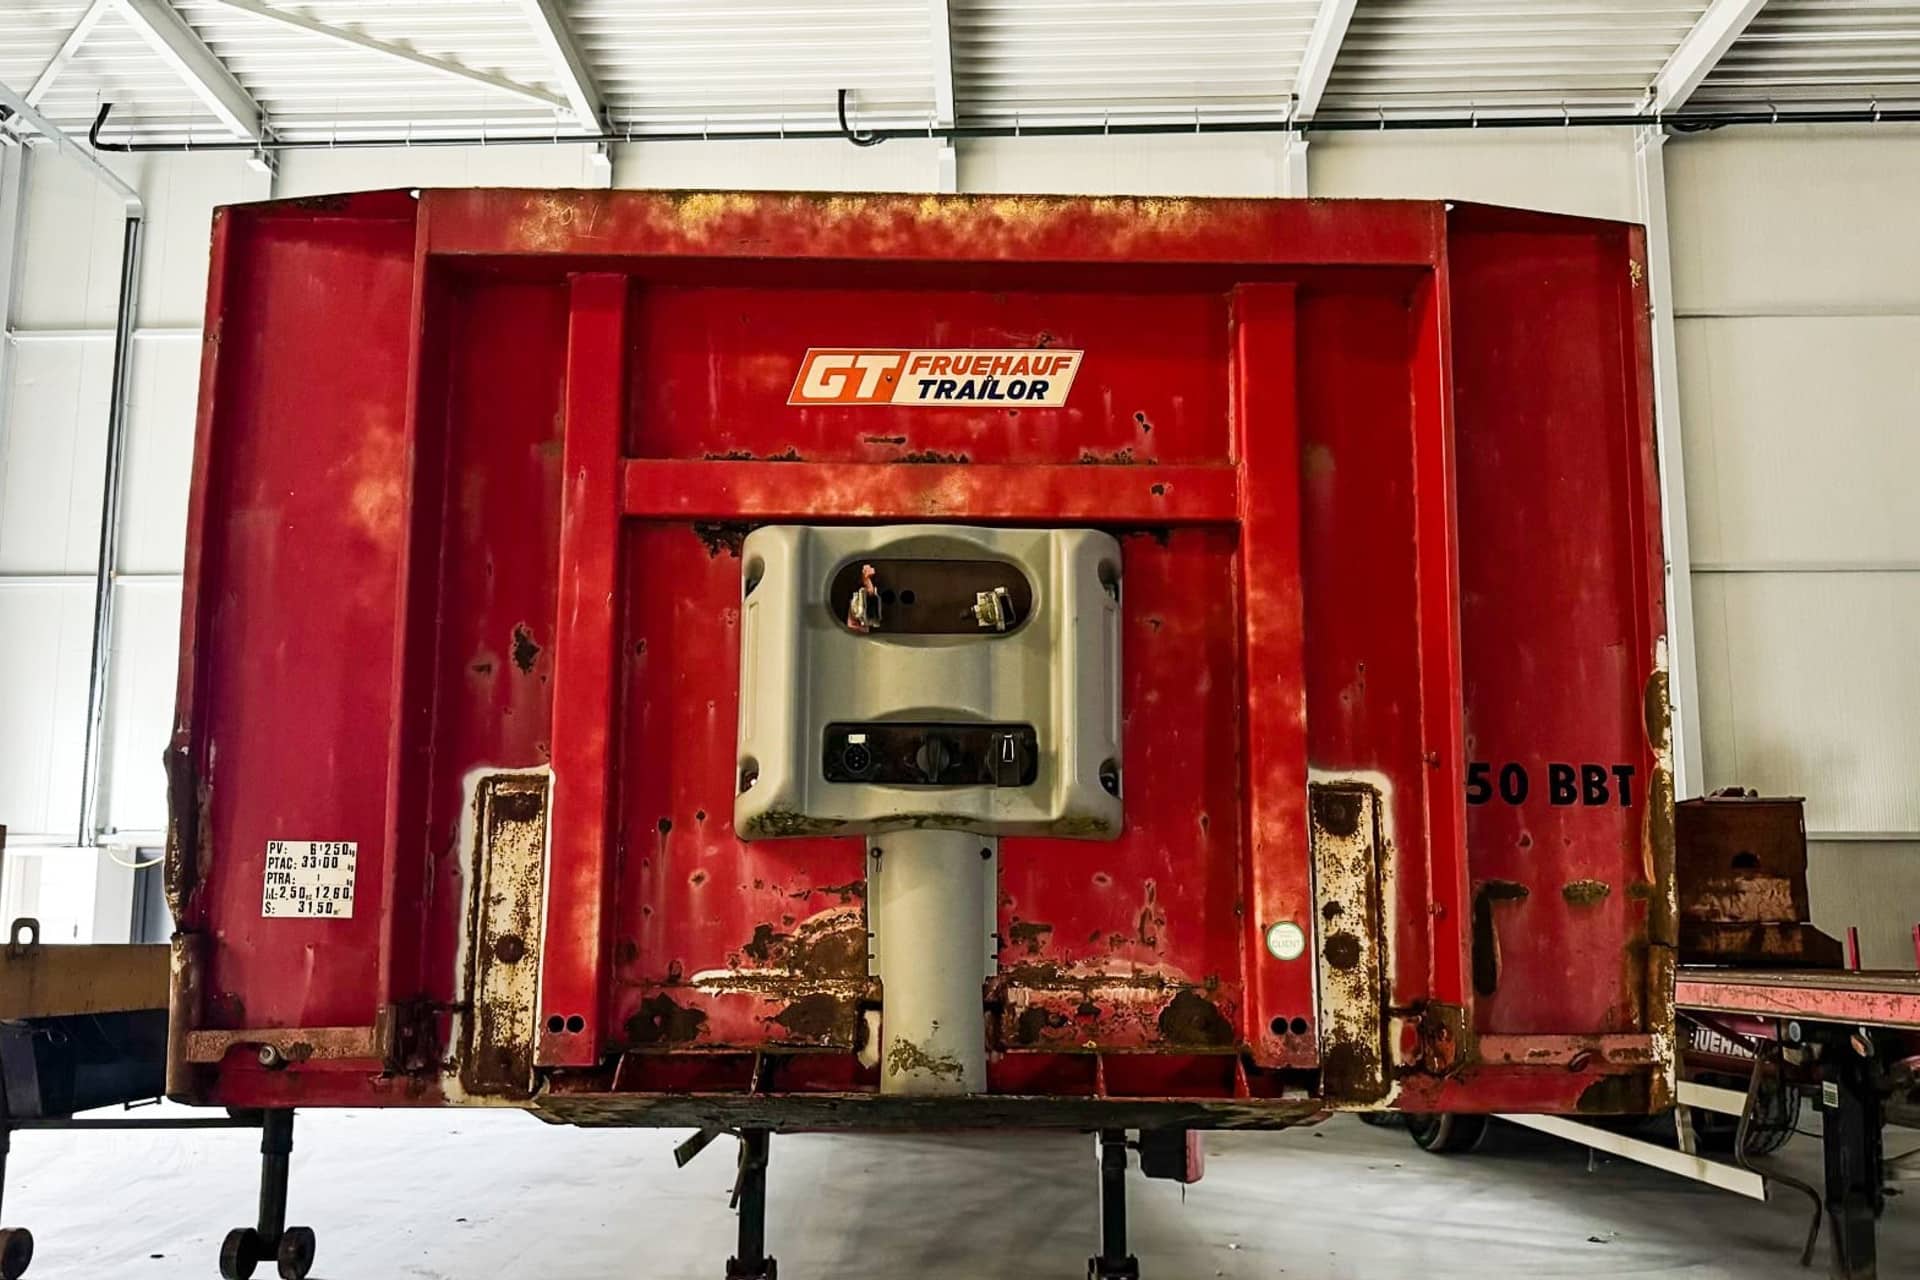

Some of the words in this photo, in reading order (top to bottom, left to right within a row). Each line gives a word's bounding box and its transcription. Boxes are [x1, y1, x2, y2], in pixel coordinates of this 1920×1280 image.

[908, 355, 1073, 376] FRUEHAUF
[801, 354, 901, 399] GT
[917, 379, 1049, 401] TRAILOR
[1466, 762, 1529, 806] 50
[1548, 763, 1635, 807] BBT
[269, 842, 288, 854] PV:
[268, 857, 297, 869] PTAC:
[267, 872, 295, 885] PTRA:
